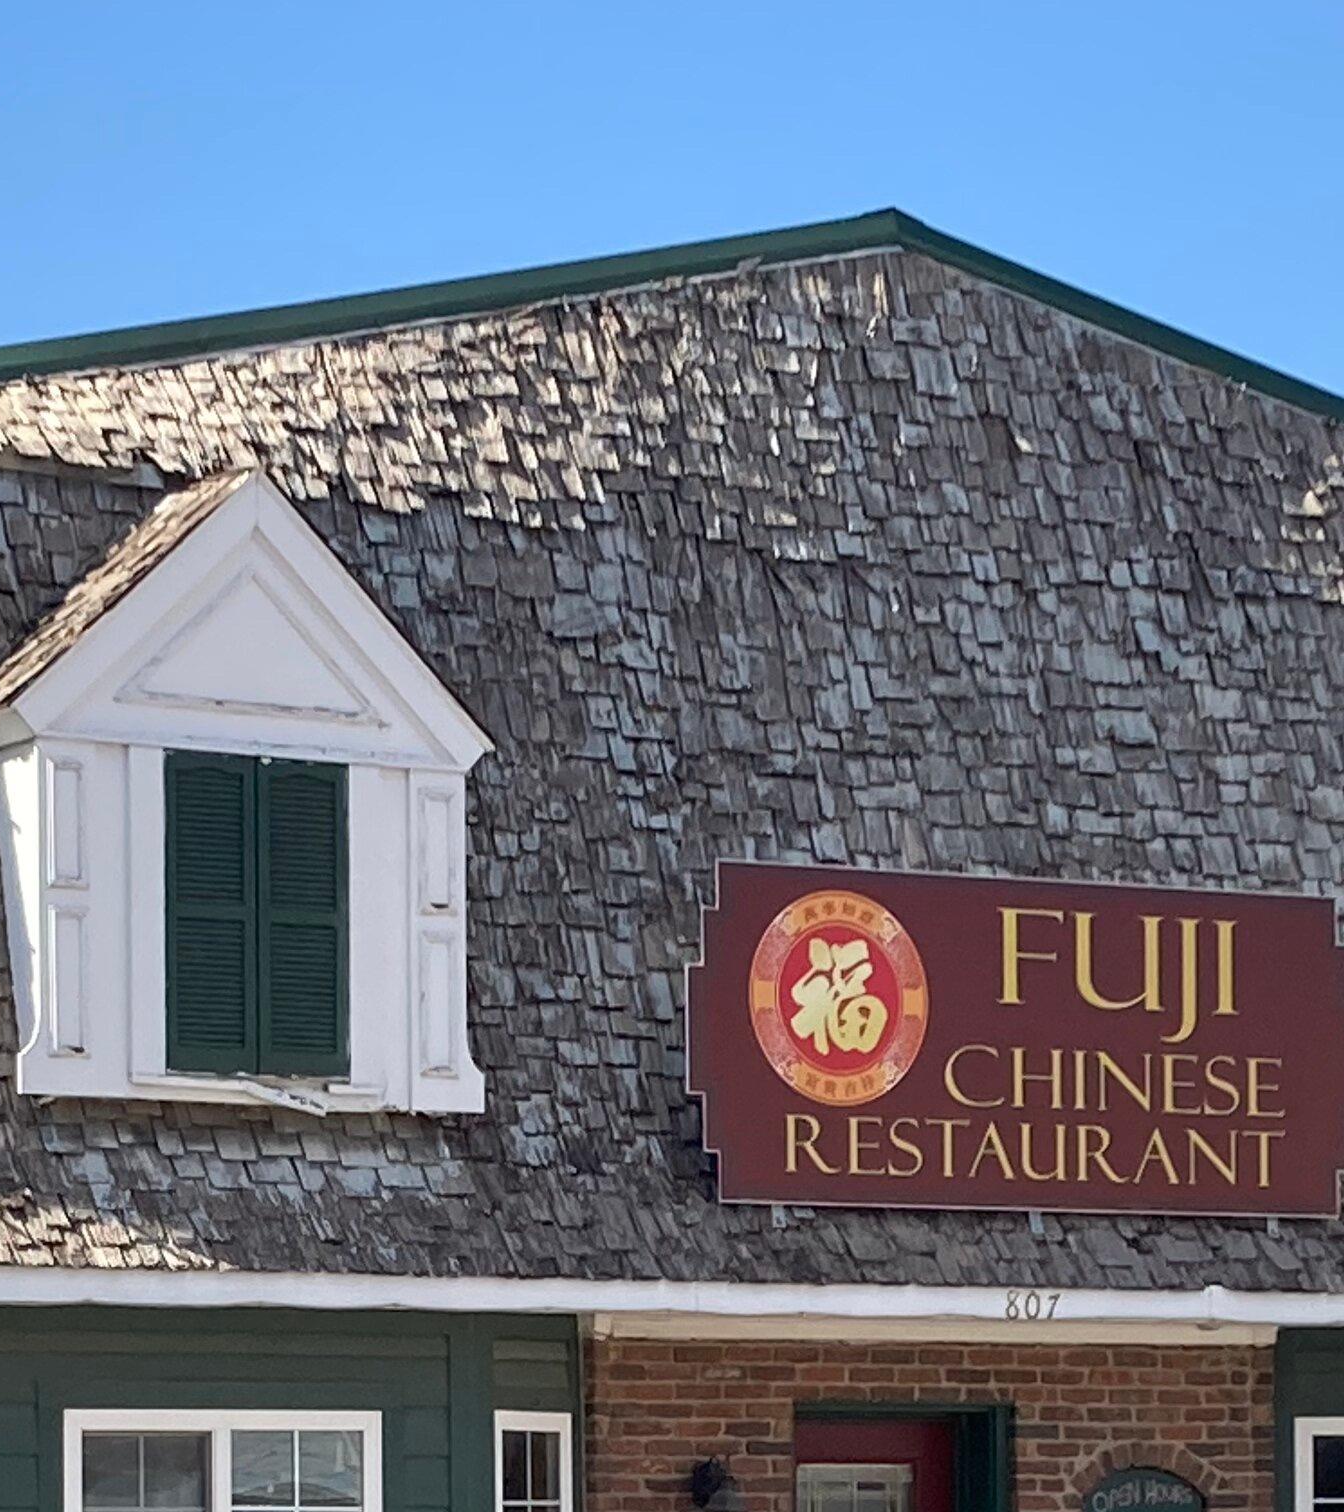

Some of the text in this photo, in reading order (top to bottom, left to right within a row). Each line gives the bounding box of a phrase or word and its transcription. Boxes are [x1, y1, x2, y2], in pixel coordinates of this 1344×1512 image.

[791, 937, 889, 1056] 福
[996, 905, 1240, 1044] FUJI
[943, 1044, 1287, 1118] CHINESE
[784, 1113, 1287, 1188] RESTAURANT
[1005, 1289, 1061, 1320] 807
